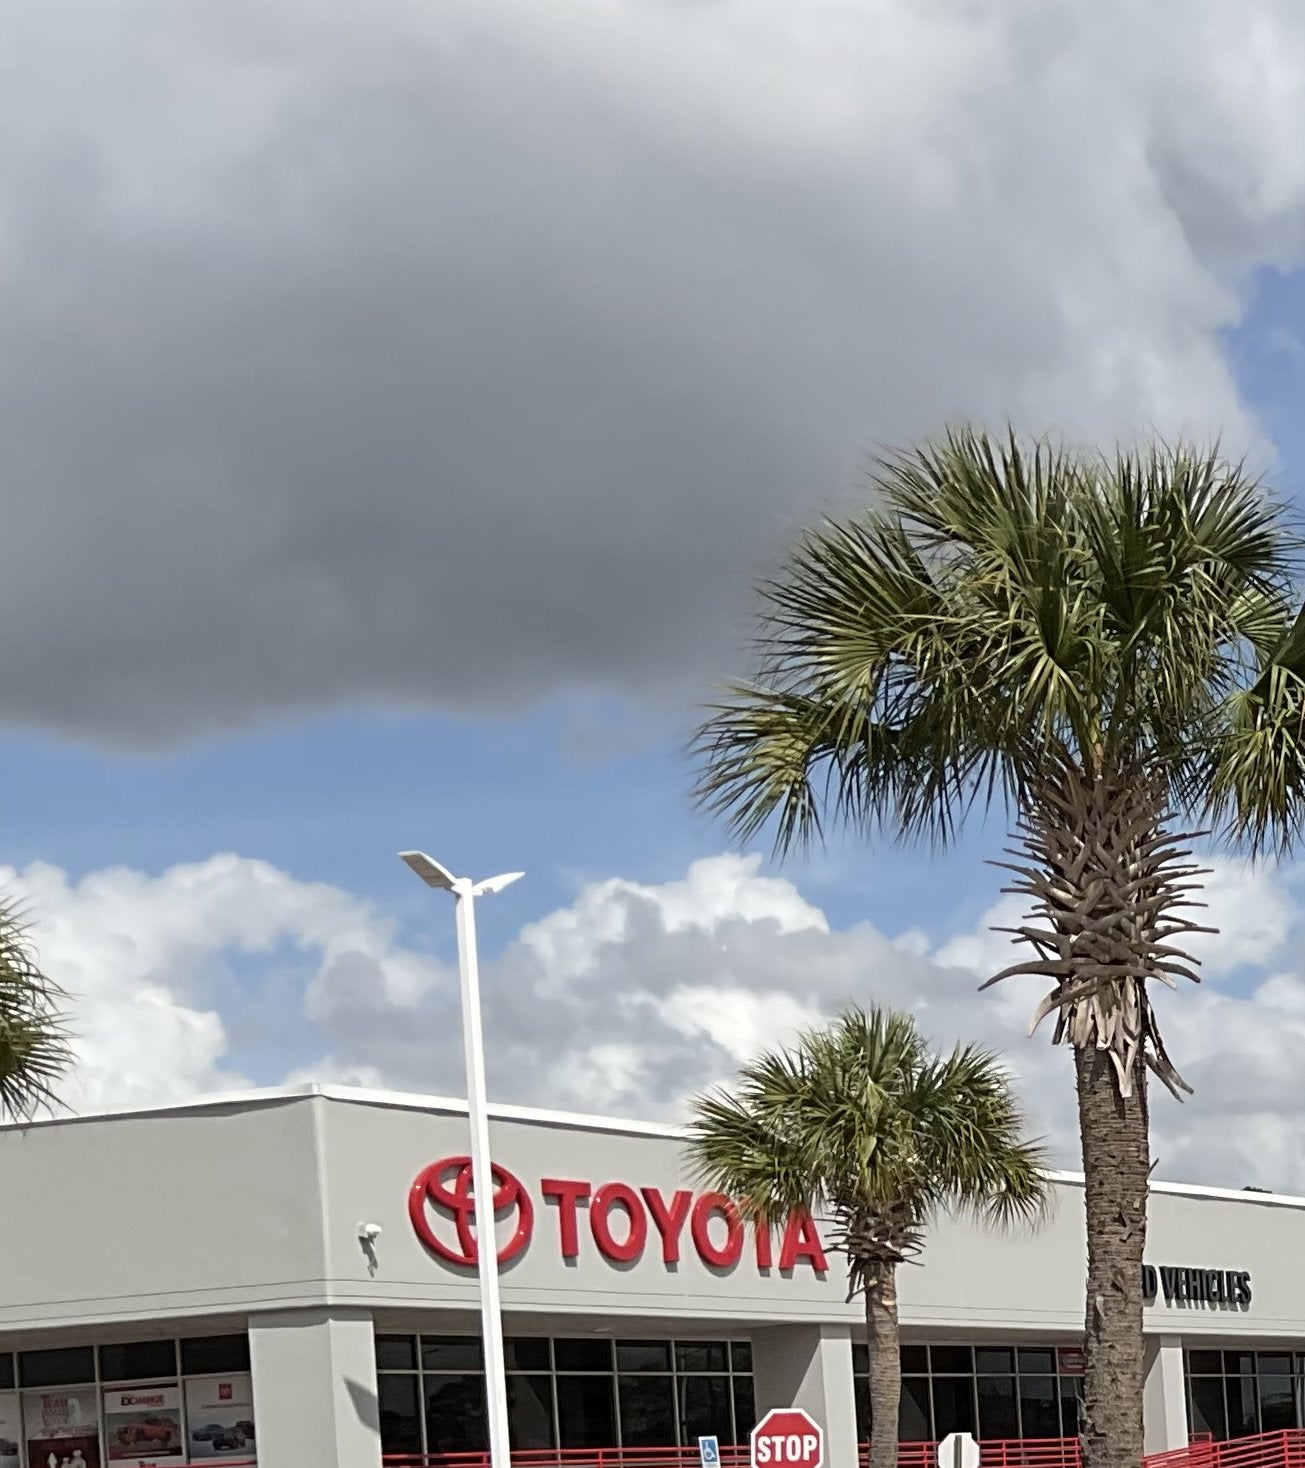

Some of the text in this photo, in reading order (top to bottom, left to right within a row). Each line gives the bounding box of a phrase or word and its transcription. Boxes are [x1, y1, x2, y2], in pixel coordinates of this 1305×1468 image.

[541, 1178, 829, 1272] TOYOTA
[1159, 1266, 1252, 1304] VEHICLES
[757, 1434, 818, 1463] STOP
